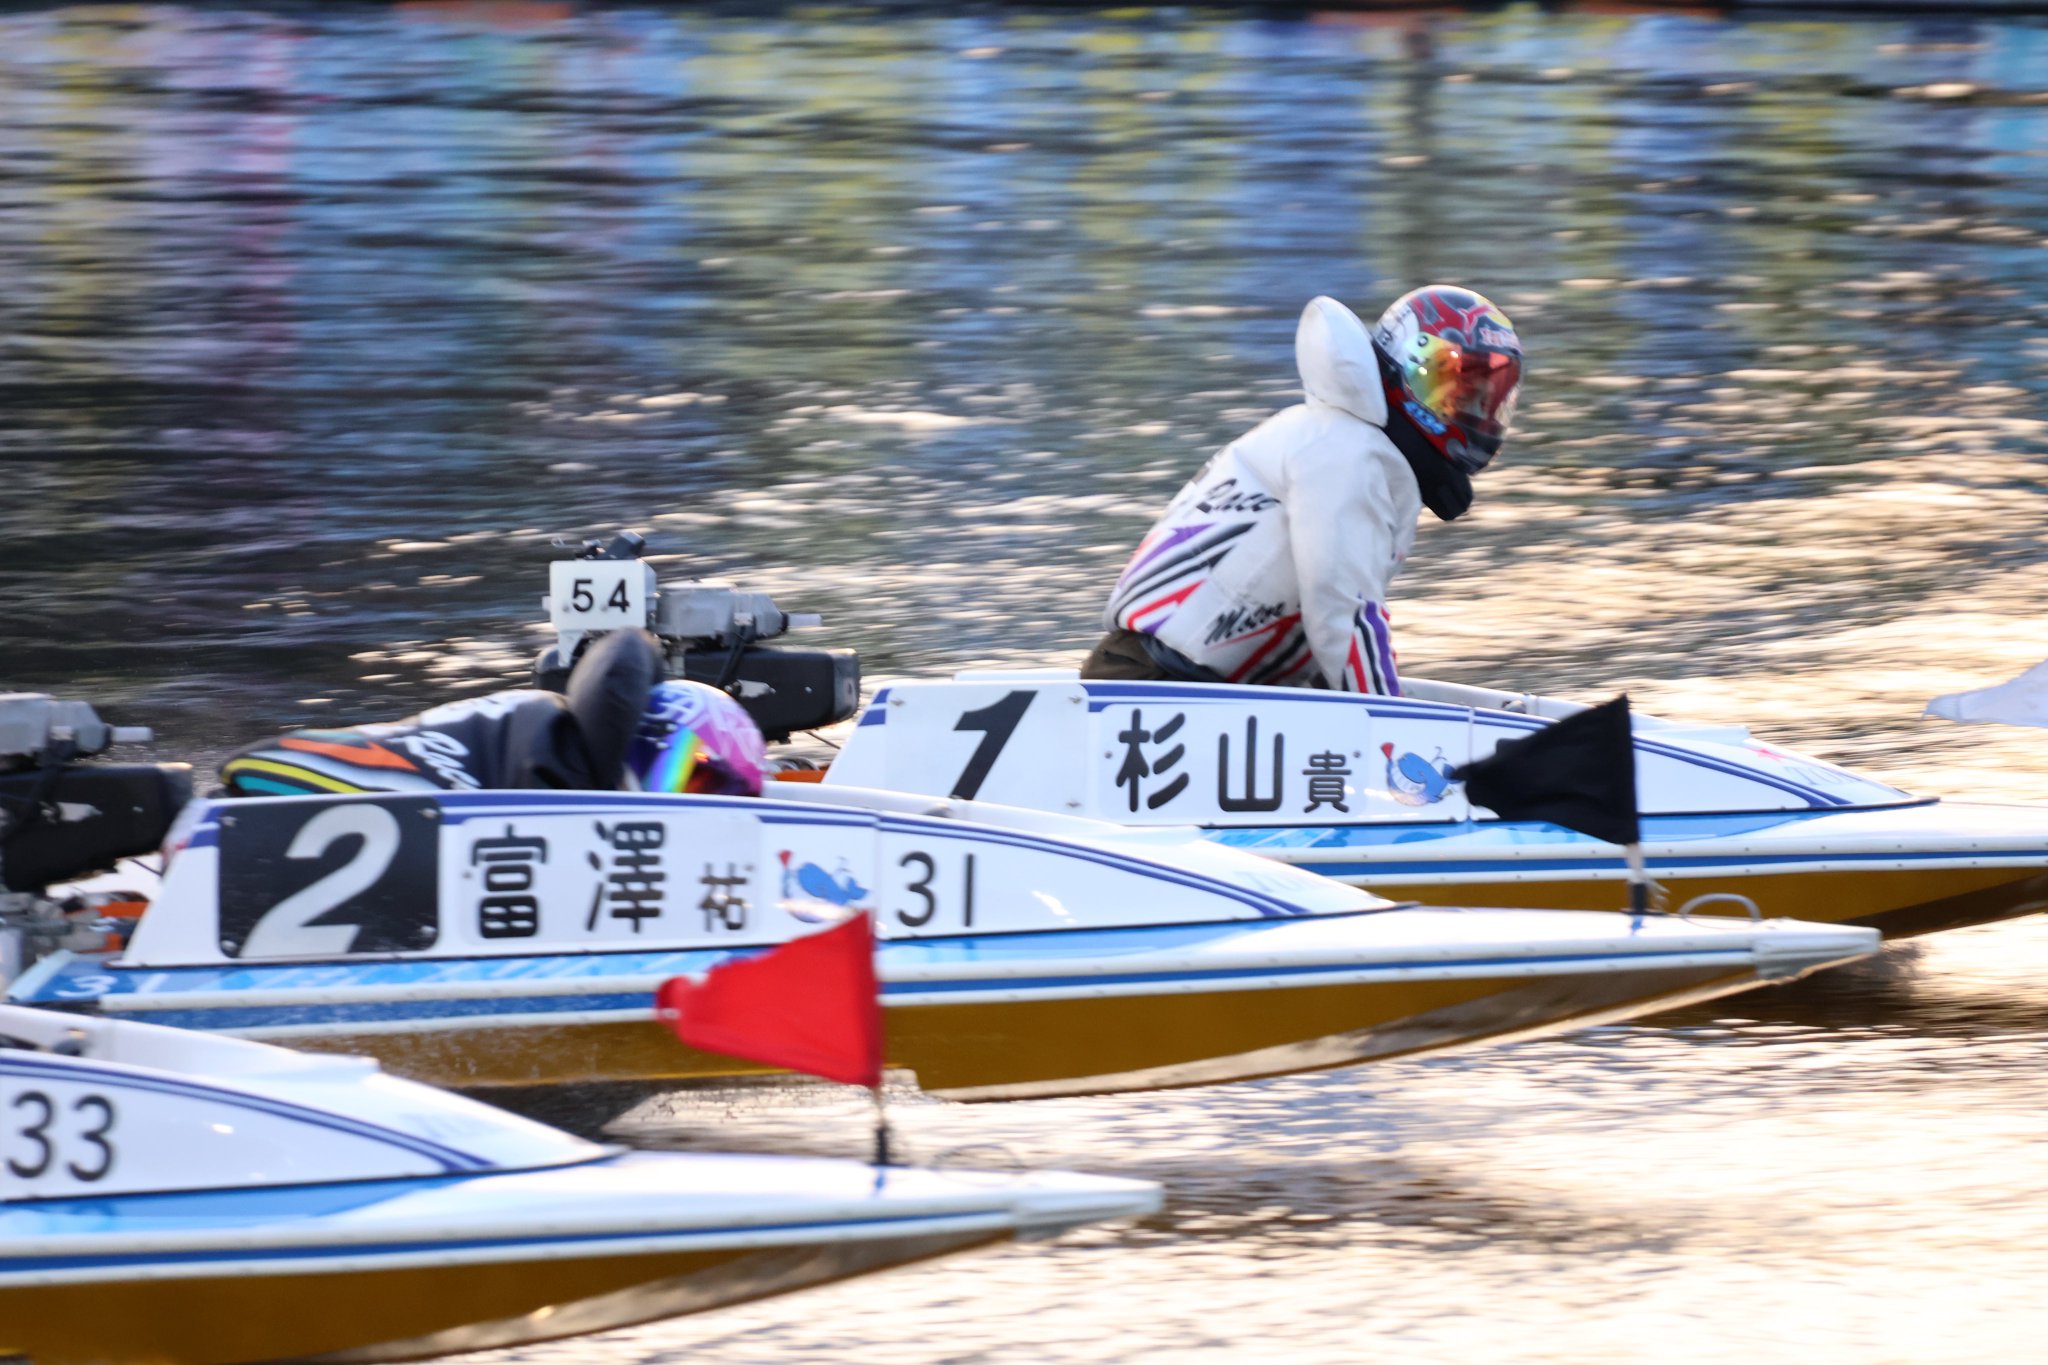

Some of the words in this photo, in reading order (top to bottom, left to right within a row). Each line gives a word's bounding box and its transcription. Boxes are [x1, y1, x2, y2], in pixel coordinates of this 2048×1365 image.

[571, 578, 630, 613] 54
[951, 690, 1038, 800] 1
[1116, 708, 1353, 813] 杉山貴
[239, 803, 401, 958] 2
[896, 850, 975, 928] 31
[7, 1090, 119, 1182] 33
